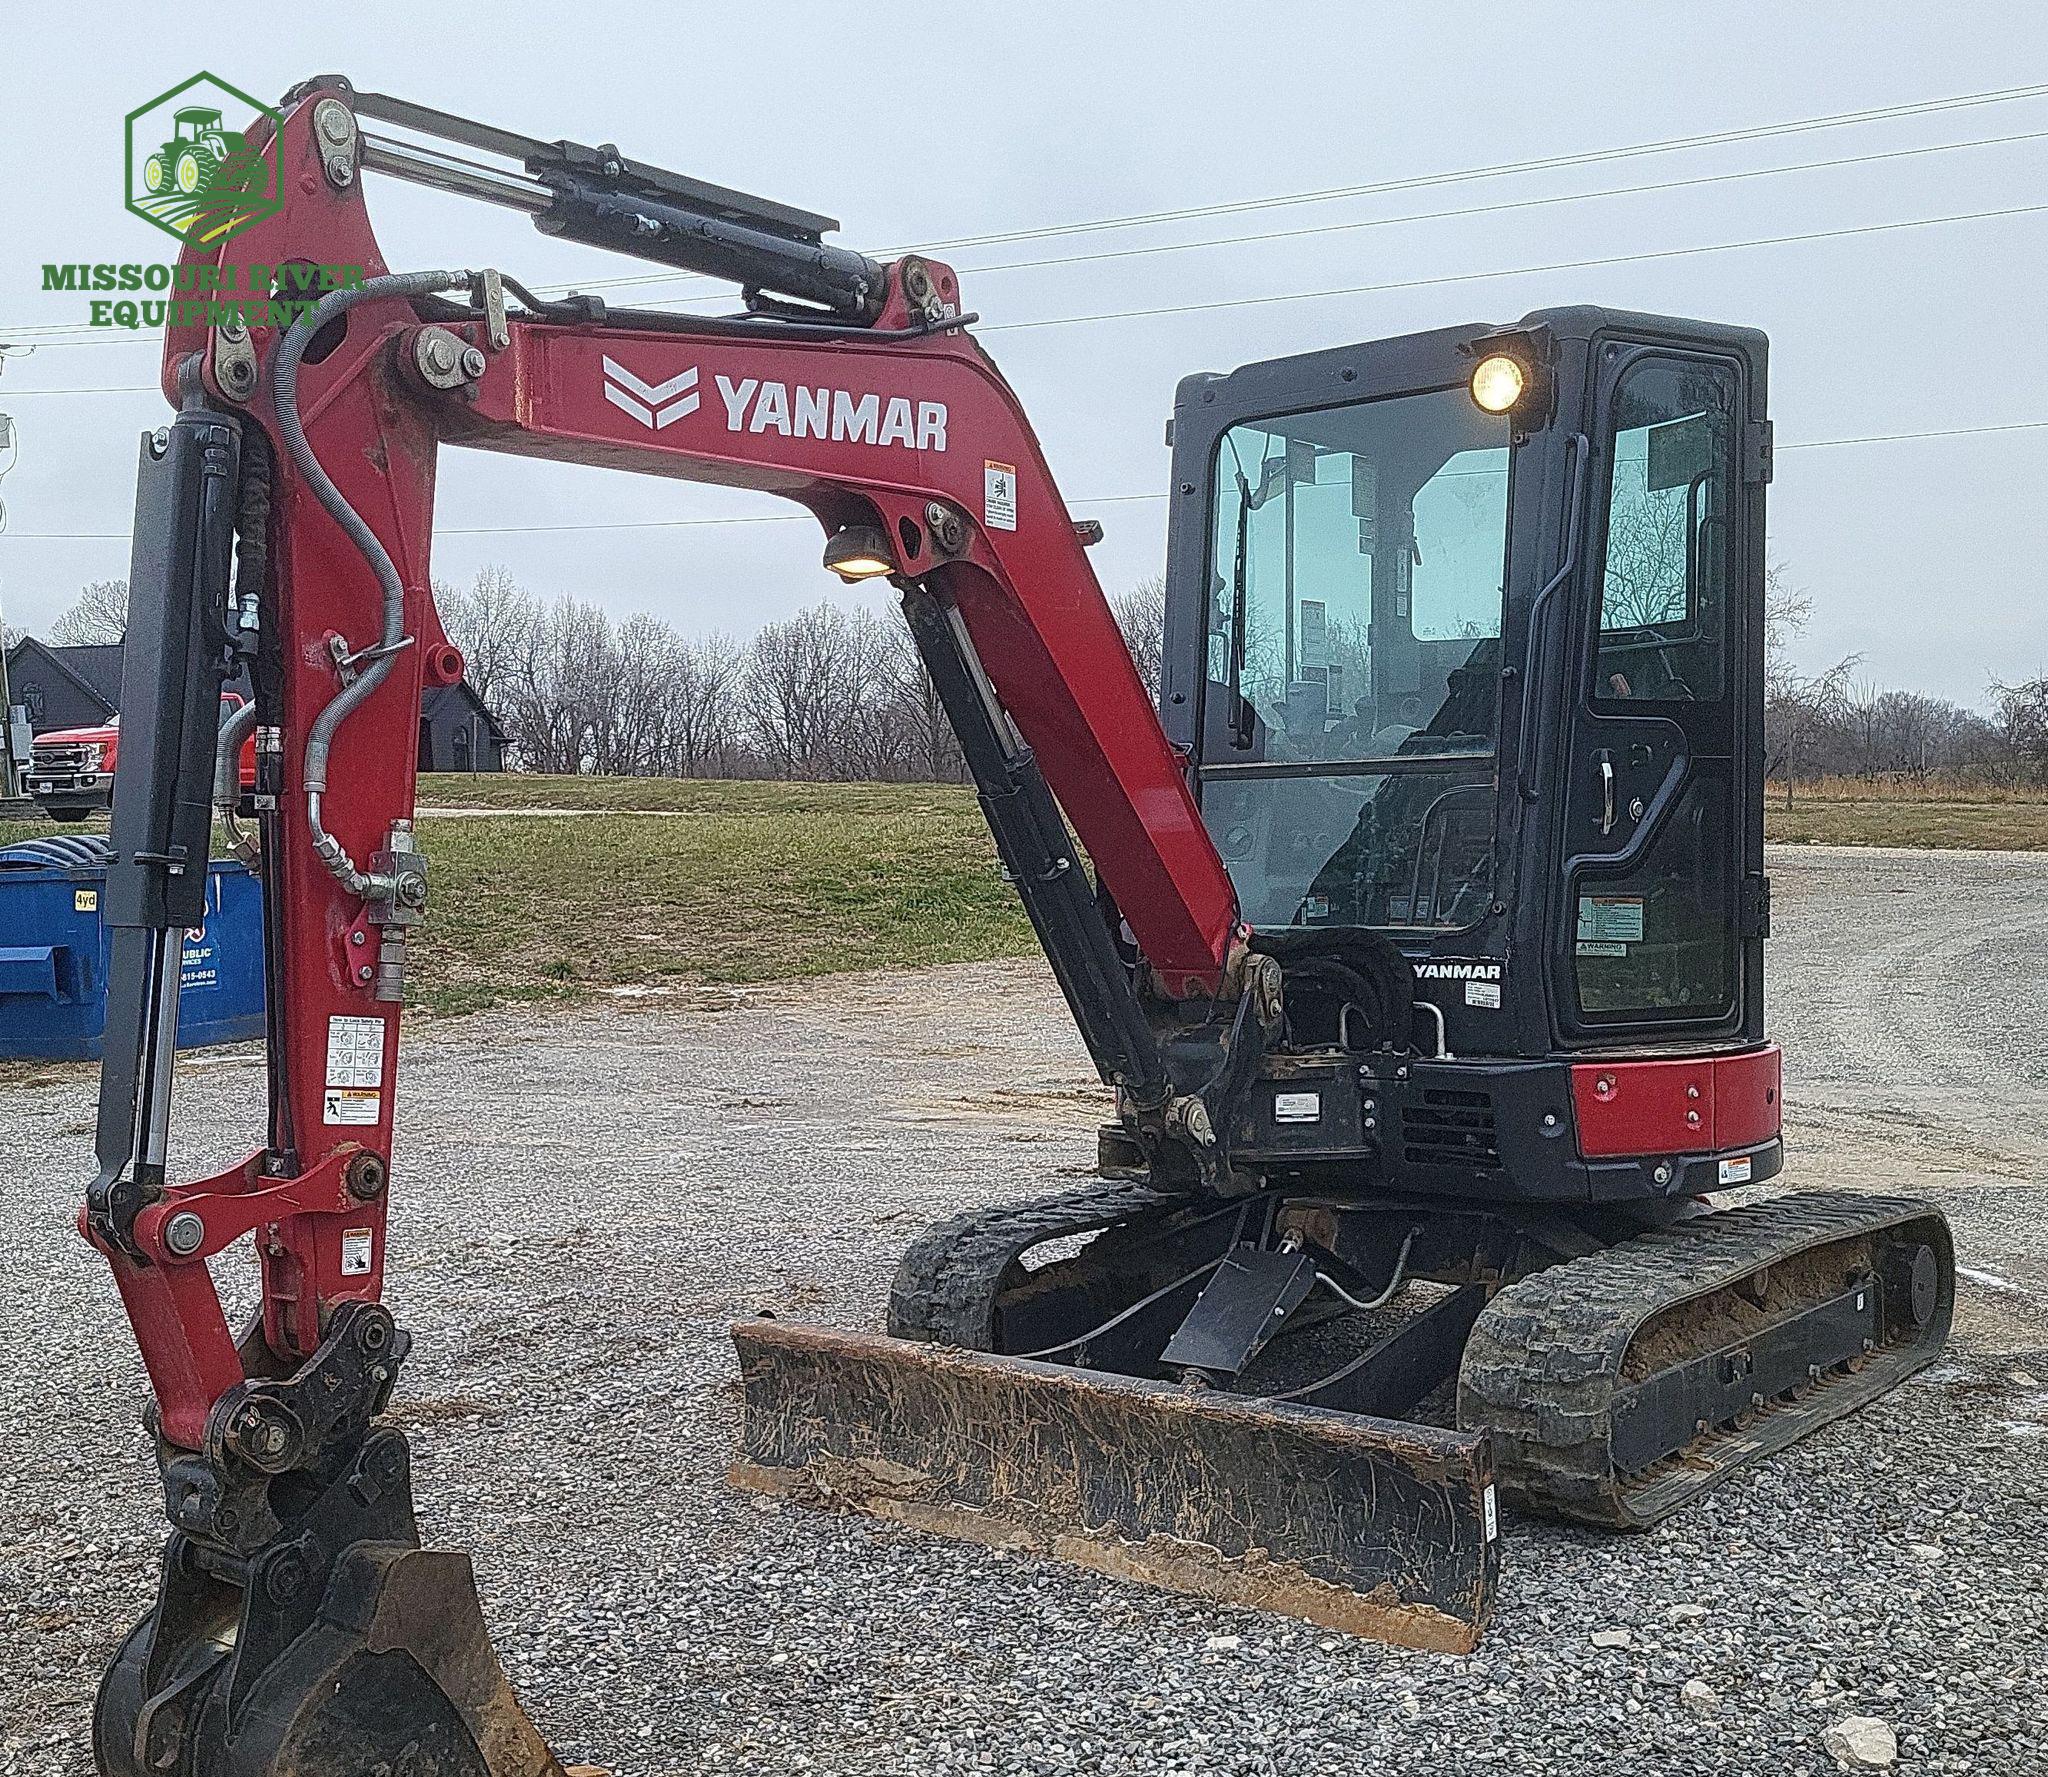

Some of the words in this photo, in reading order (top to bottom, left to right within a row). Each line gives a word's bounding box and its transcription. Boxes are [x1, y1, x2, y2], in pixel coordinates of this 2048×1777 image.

[714, 375, 948, 452] YANMAR
[76, 894, 96, 908] 4yd
[182, 948, 213, 959] UBLIC
[181, 970, 216, 982] -815-0543
[1413, 964, 1501, 979] YANMAR
